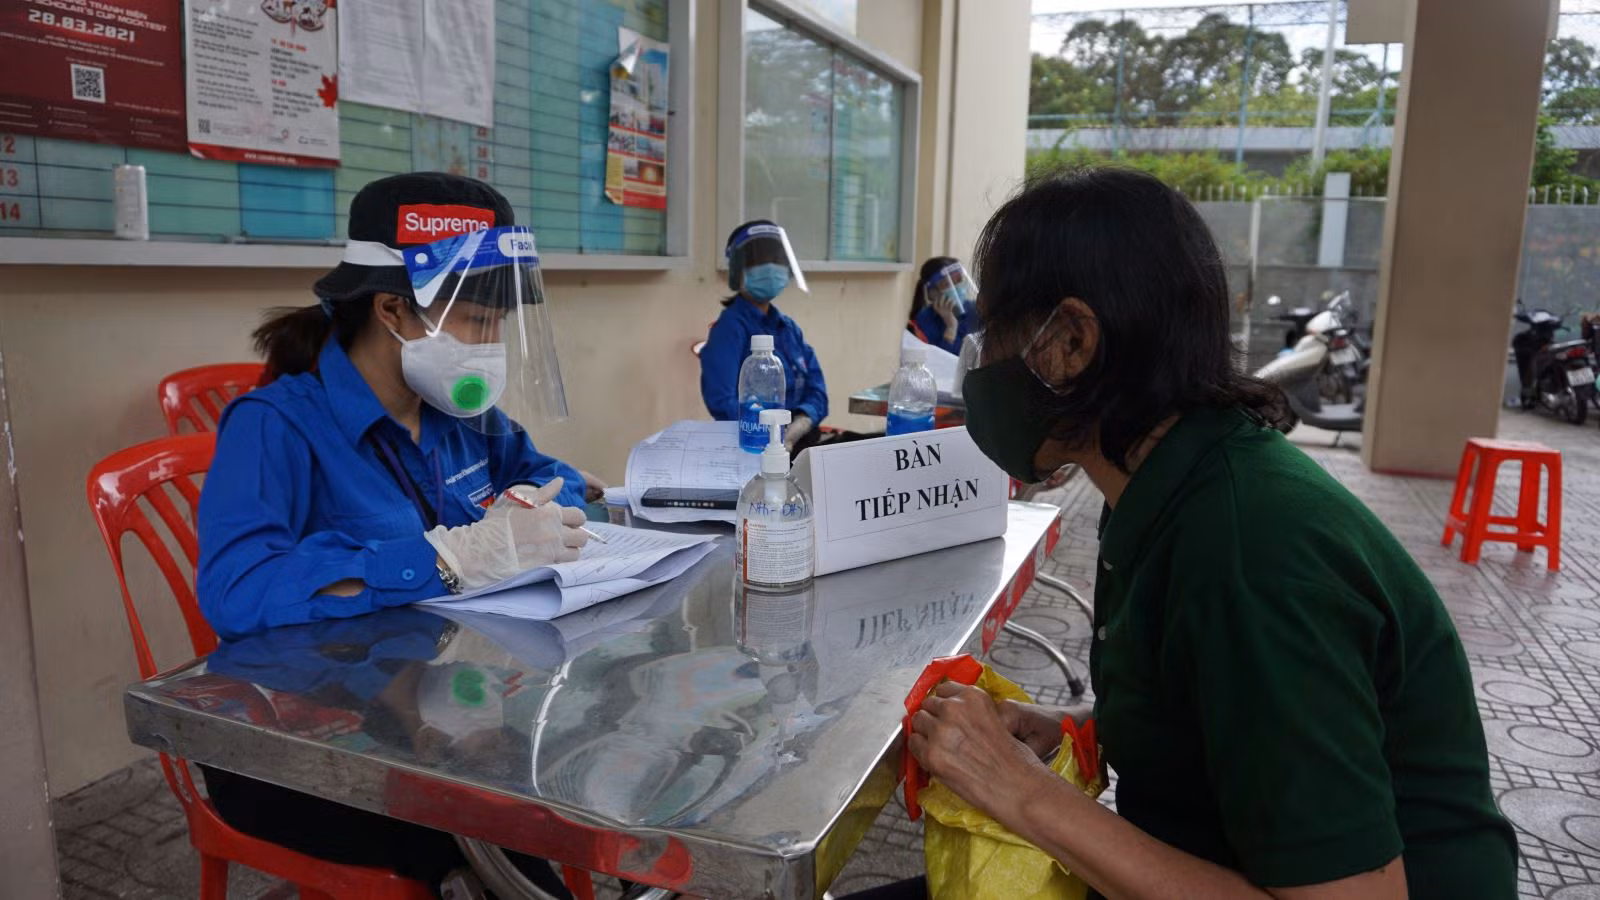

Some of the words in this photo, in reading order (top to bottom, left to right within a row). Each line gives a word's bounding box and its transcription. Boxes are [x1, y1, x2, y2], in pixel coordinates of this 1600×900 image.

[28, 9, 136, 43] 28.03.2021
[0, 201, 20, 220] 14
[405, 212, 489, 236] Supreme
[894, 440, 942, 472] BÀN
[856, 487, 911, 522] TIẾP
[917, 478, 979, 510] NHẬN
